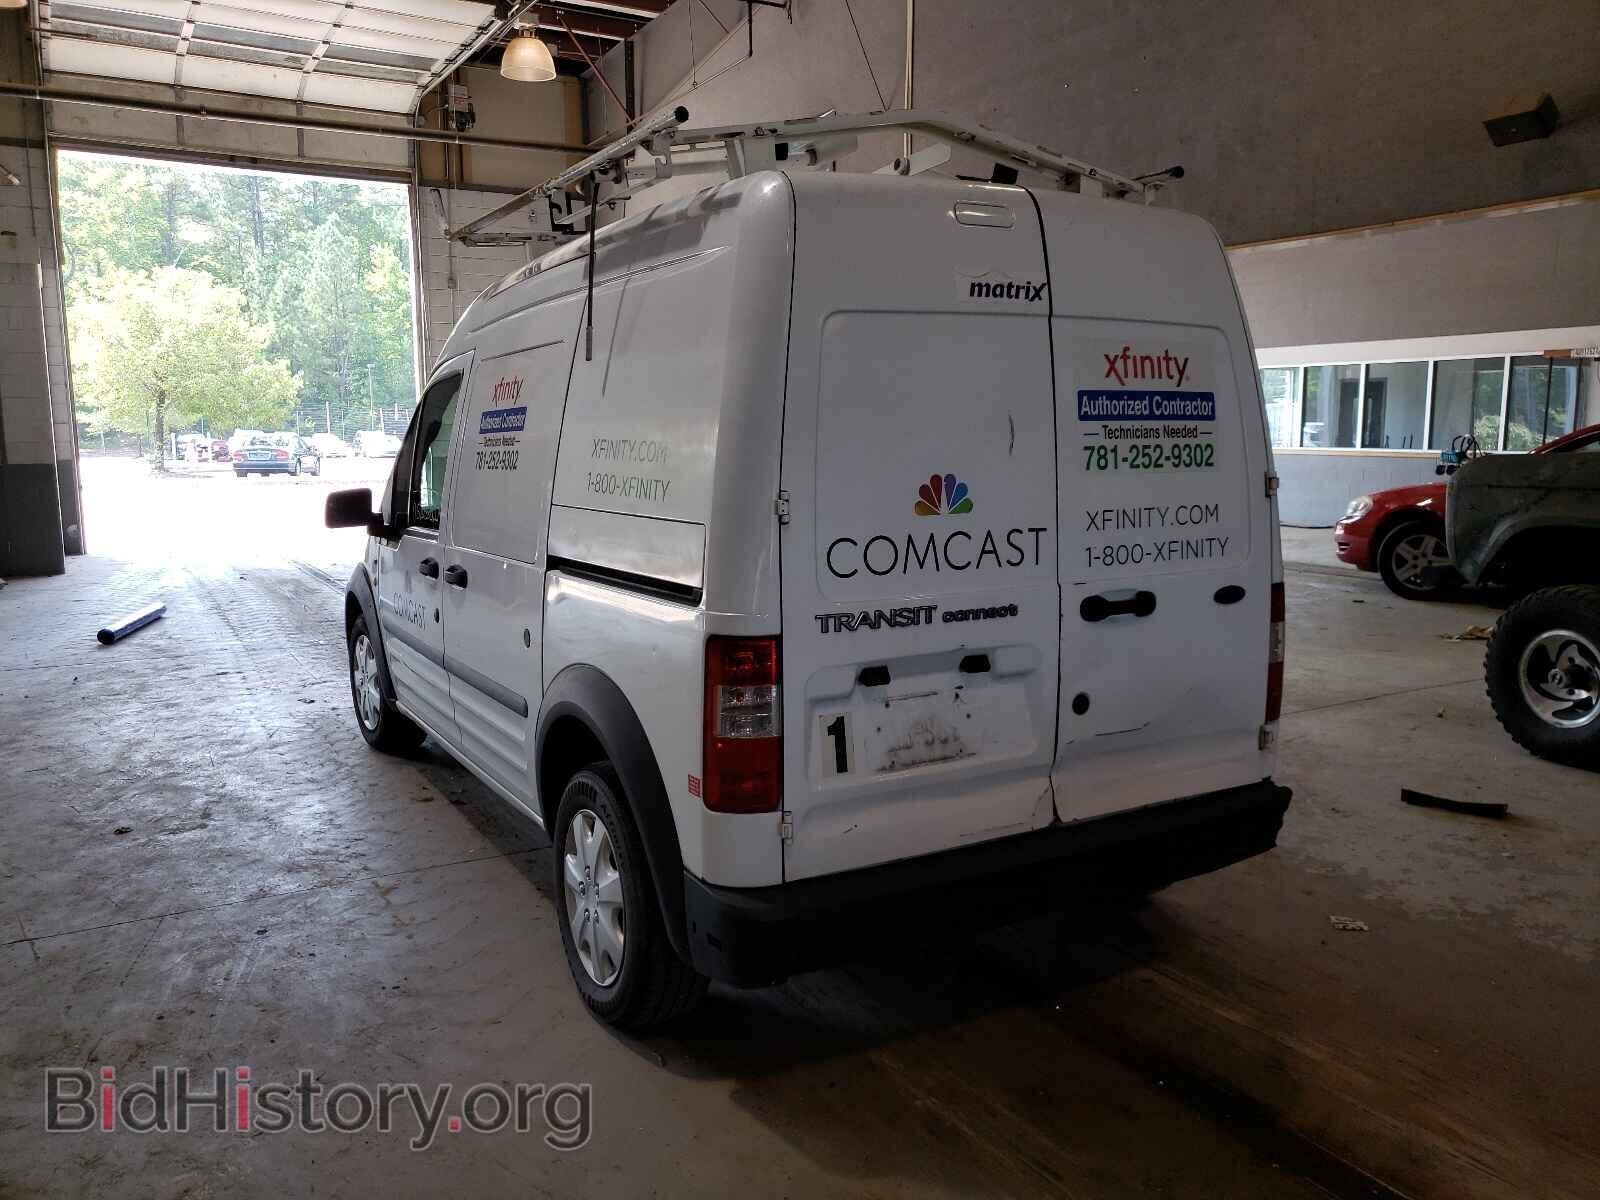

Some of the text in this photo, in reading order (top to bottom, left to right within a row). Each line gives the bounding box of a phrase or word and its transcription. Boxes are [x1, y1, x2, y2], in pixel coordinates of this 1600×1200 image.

[969, 281, 1047, 302] matrix
[1104, 346, 1189, 387] xfinity
[492, 376, 524, 407] xfinity
[1080, 395, 1213, 417] Authorized Contractor
[1102, 425, 1198, 439] Technicians Needed
[592, 438, 668, 464] XFINITY.COM
[1084, 444, 1215, 471] 781-252-9302
[586, 472, 671, 501] 1-800-XFINITY
[1085, 503, 1219, 532] XFINITY.COM
[827, 527, 1047, 579] COMCAST
[1085, 536, 1229, 567] 1-800-XFINITY
[815, 603, 1018, 633] TRANSIT connect
[827, 715, 848, 773] 1
